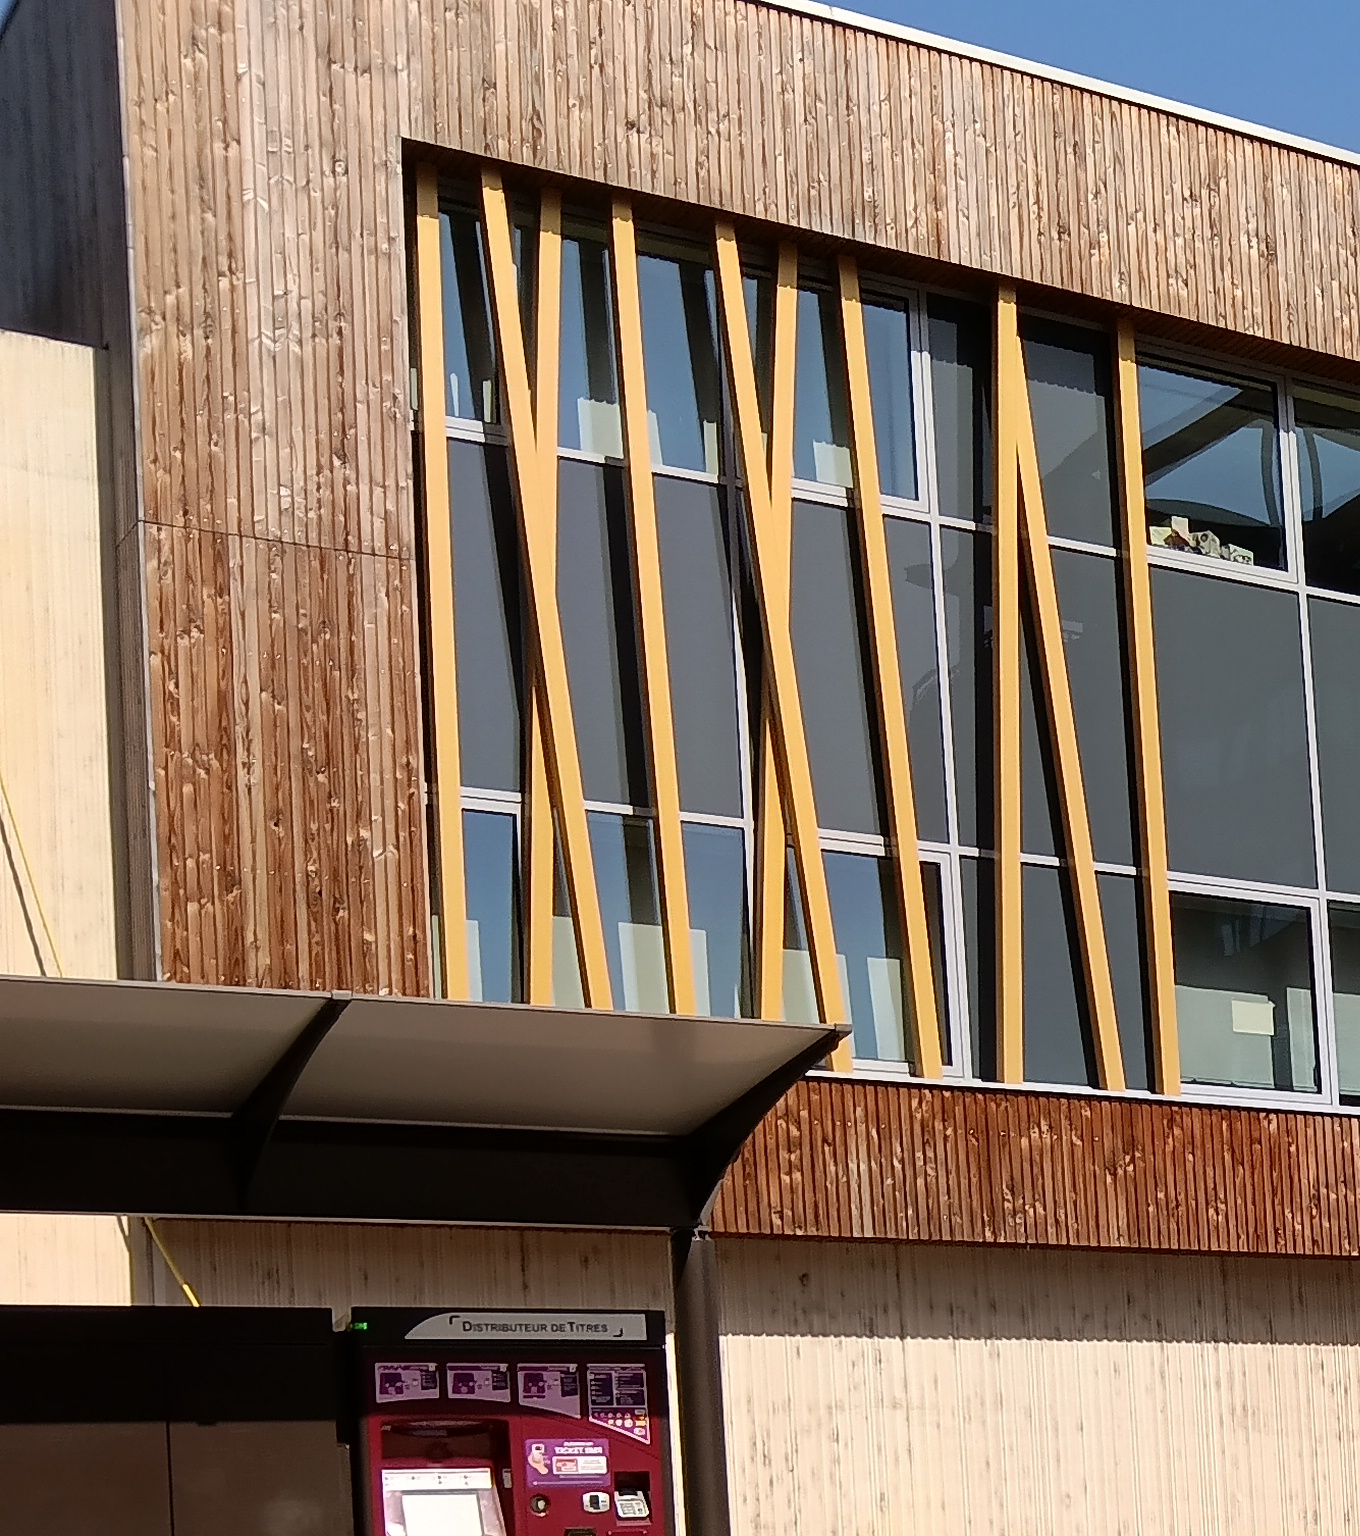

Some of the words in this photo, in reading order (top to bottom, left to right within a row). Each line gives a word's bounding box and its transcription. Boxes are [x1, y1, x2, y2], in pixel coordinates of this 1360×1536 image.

[462, 1321, 548, 1333] DISTRIBUTEUR
[551, 1323, 566, 1333] DE
[567, 1322, 608, 1333] TITRES
